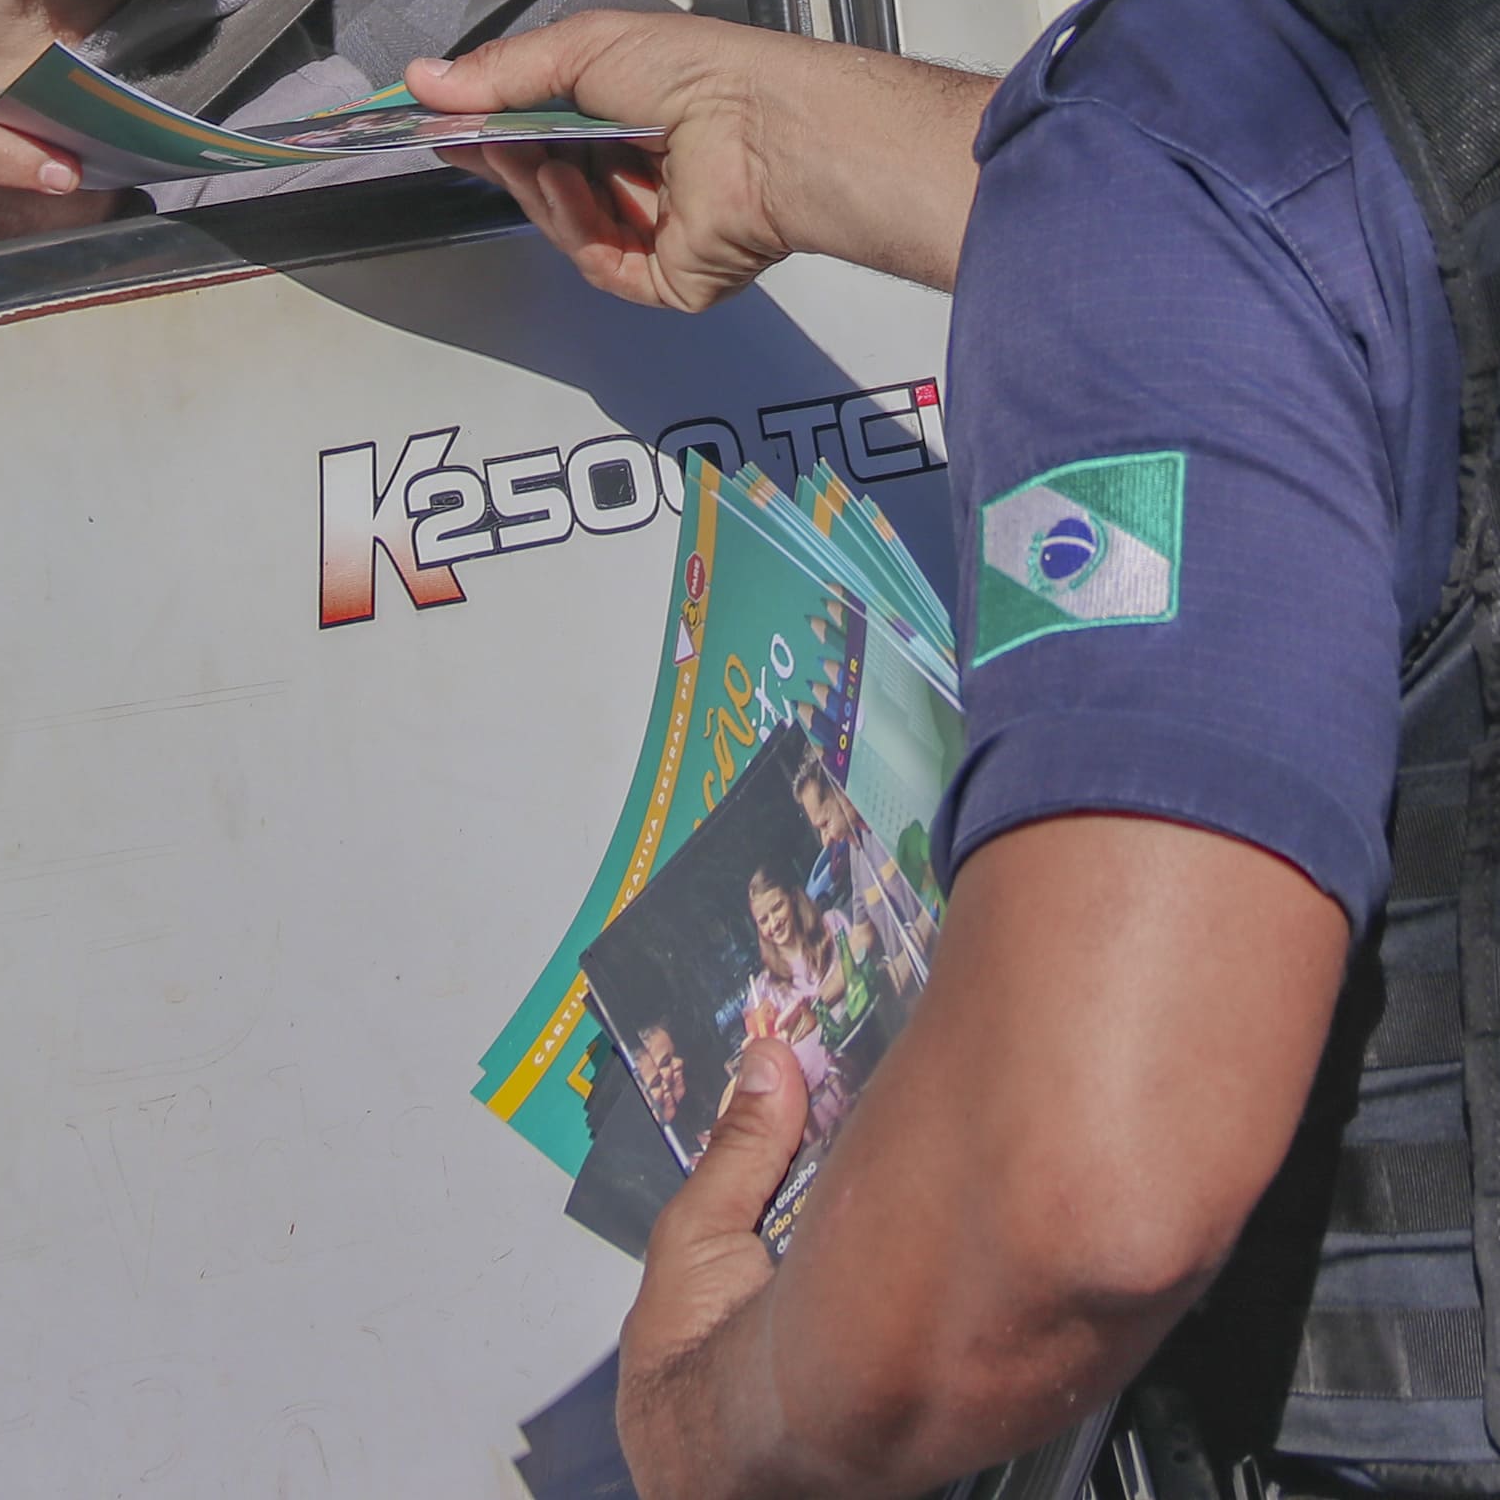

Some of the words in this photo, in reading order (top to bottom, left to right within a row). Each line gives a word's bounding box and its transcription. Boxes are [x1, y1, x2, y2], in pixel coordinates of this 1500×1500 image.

[657, 712, 684, 806] DETRAN
[680, 671, 691, 700] PR
[775, 1161, 817, 1210] escolho
[768, 1213, 792, 1241] não
